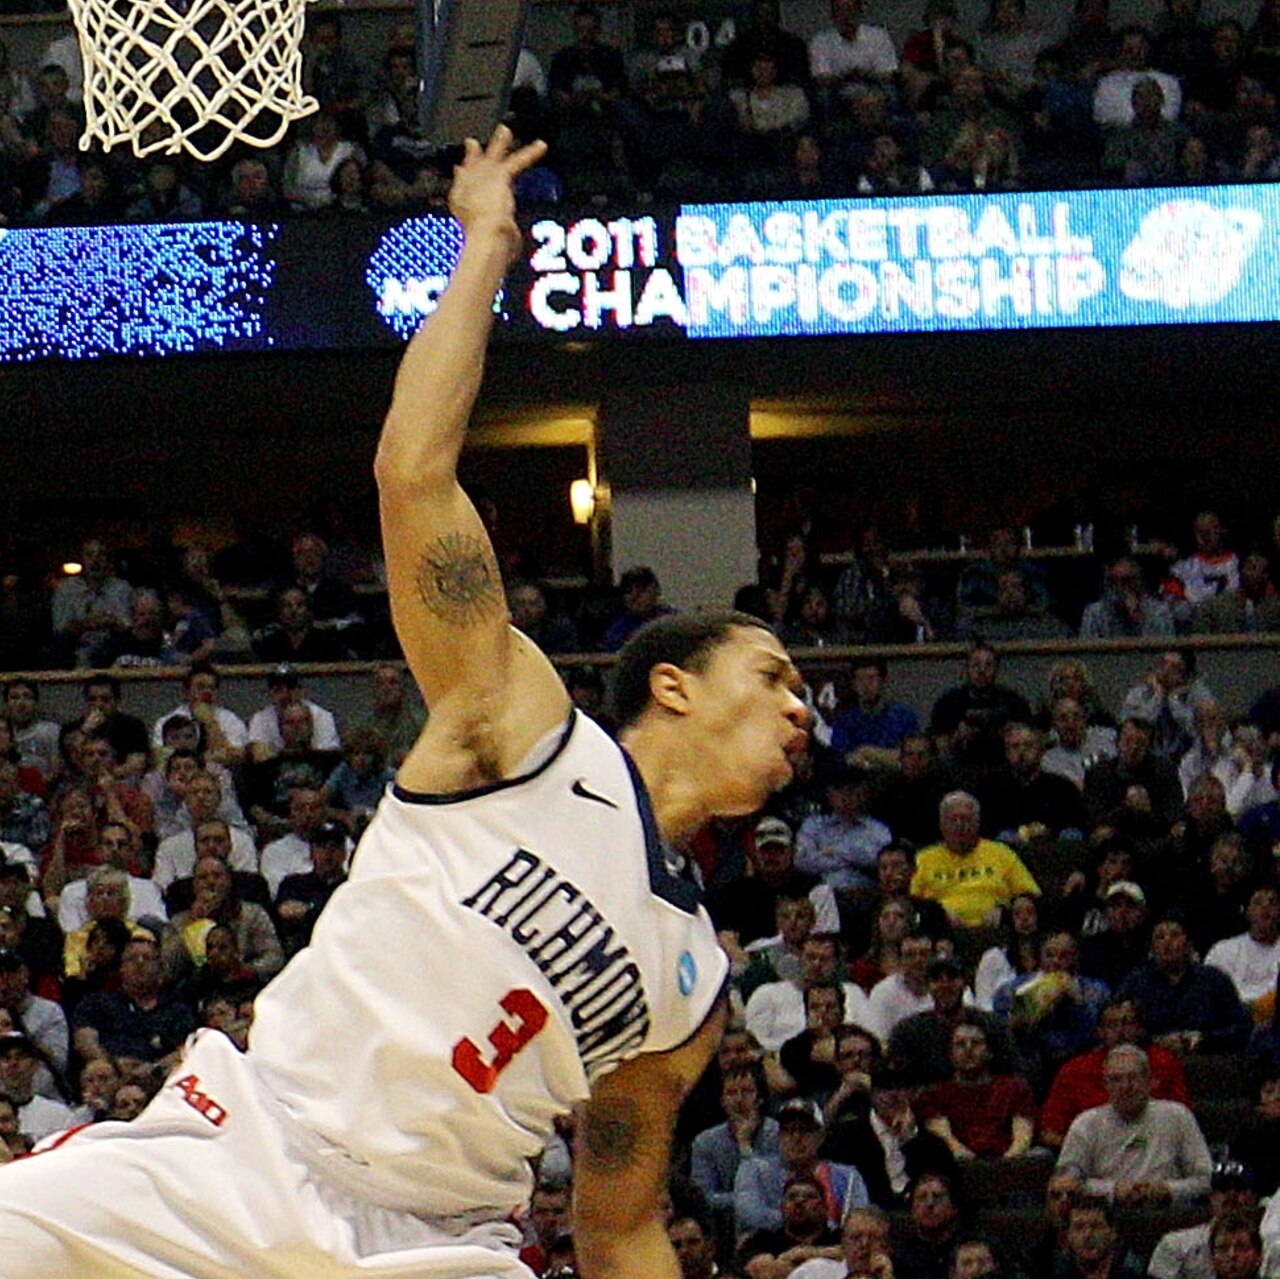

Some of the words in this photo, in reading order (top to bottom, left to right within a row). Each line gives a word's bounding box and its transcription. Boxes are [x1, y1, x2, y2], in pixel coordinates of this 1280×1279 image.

[528, 216, 659, 272] 2011
[676, 201, 1094, 267] BASKETBALL
[527, 253, 1105, 331] CHAMPIONSHIP
[451, 987, 550, 1095] 3
